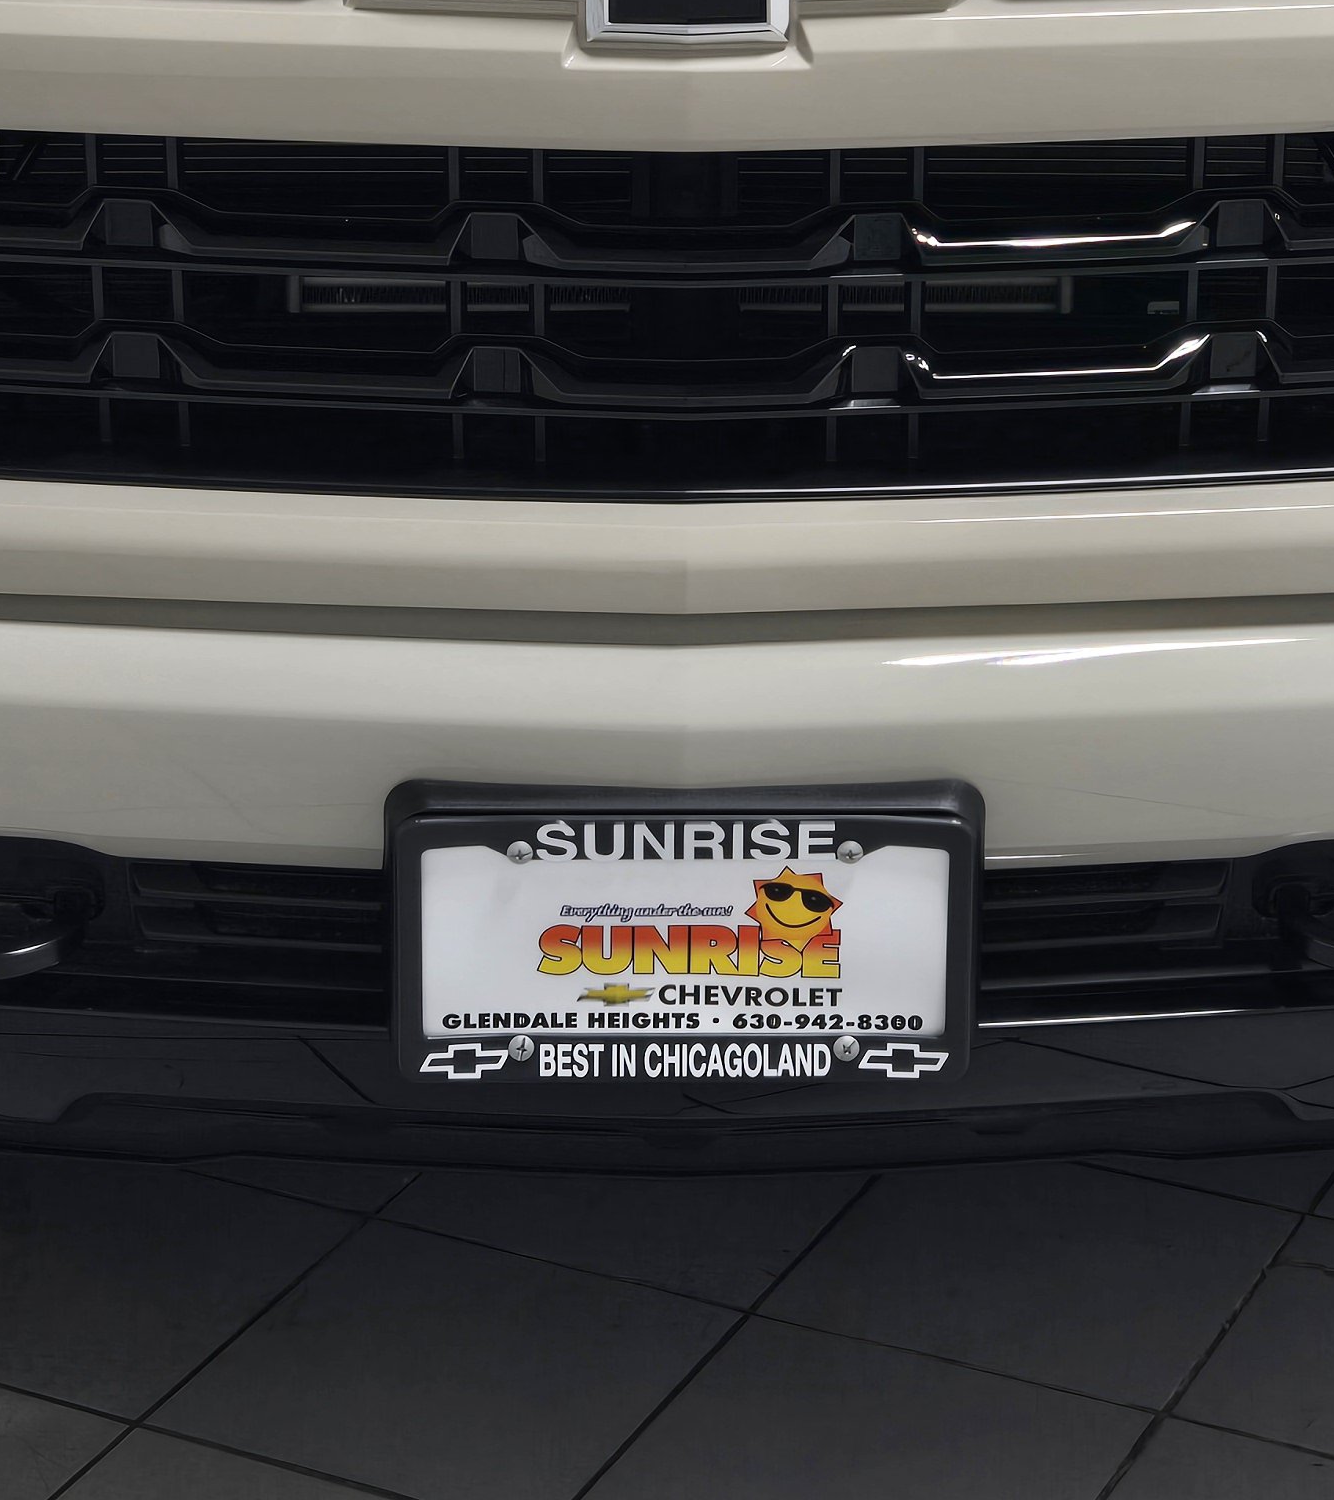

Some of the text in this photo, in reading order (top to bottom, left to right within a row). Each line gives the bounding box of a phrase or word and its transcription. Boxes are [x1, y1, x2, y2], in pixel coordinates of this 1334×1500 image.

[535, 820, 837, 861] SUNRISE
[560, 903, 634, 922] Everything
[634, 903, 678, 917] under
[677, 903, 701, 917] the
[537, 924, 841, 978] SUNRISE
[658, 984, 843, 1007] CHEVROLET
[442, 1012, 923, 1031] GLENDALE HEIGHTS 630-942-8300
[539, 1042, 832, 1078] BEST IN CHICAGOLAND
